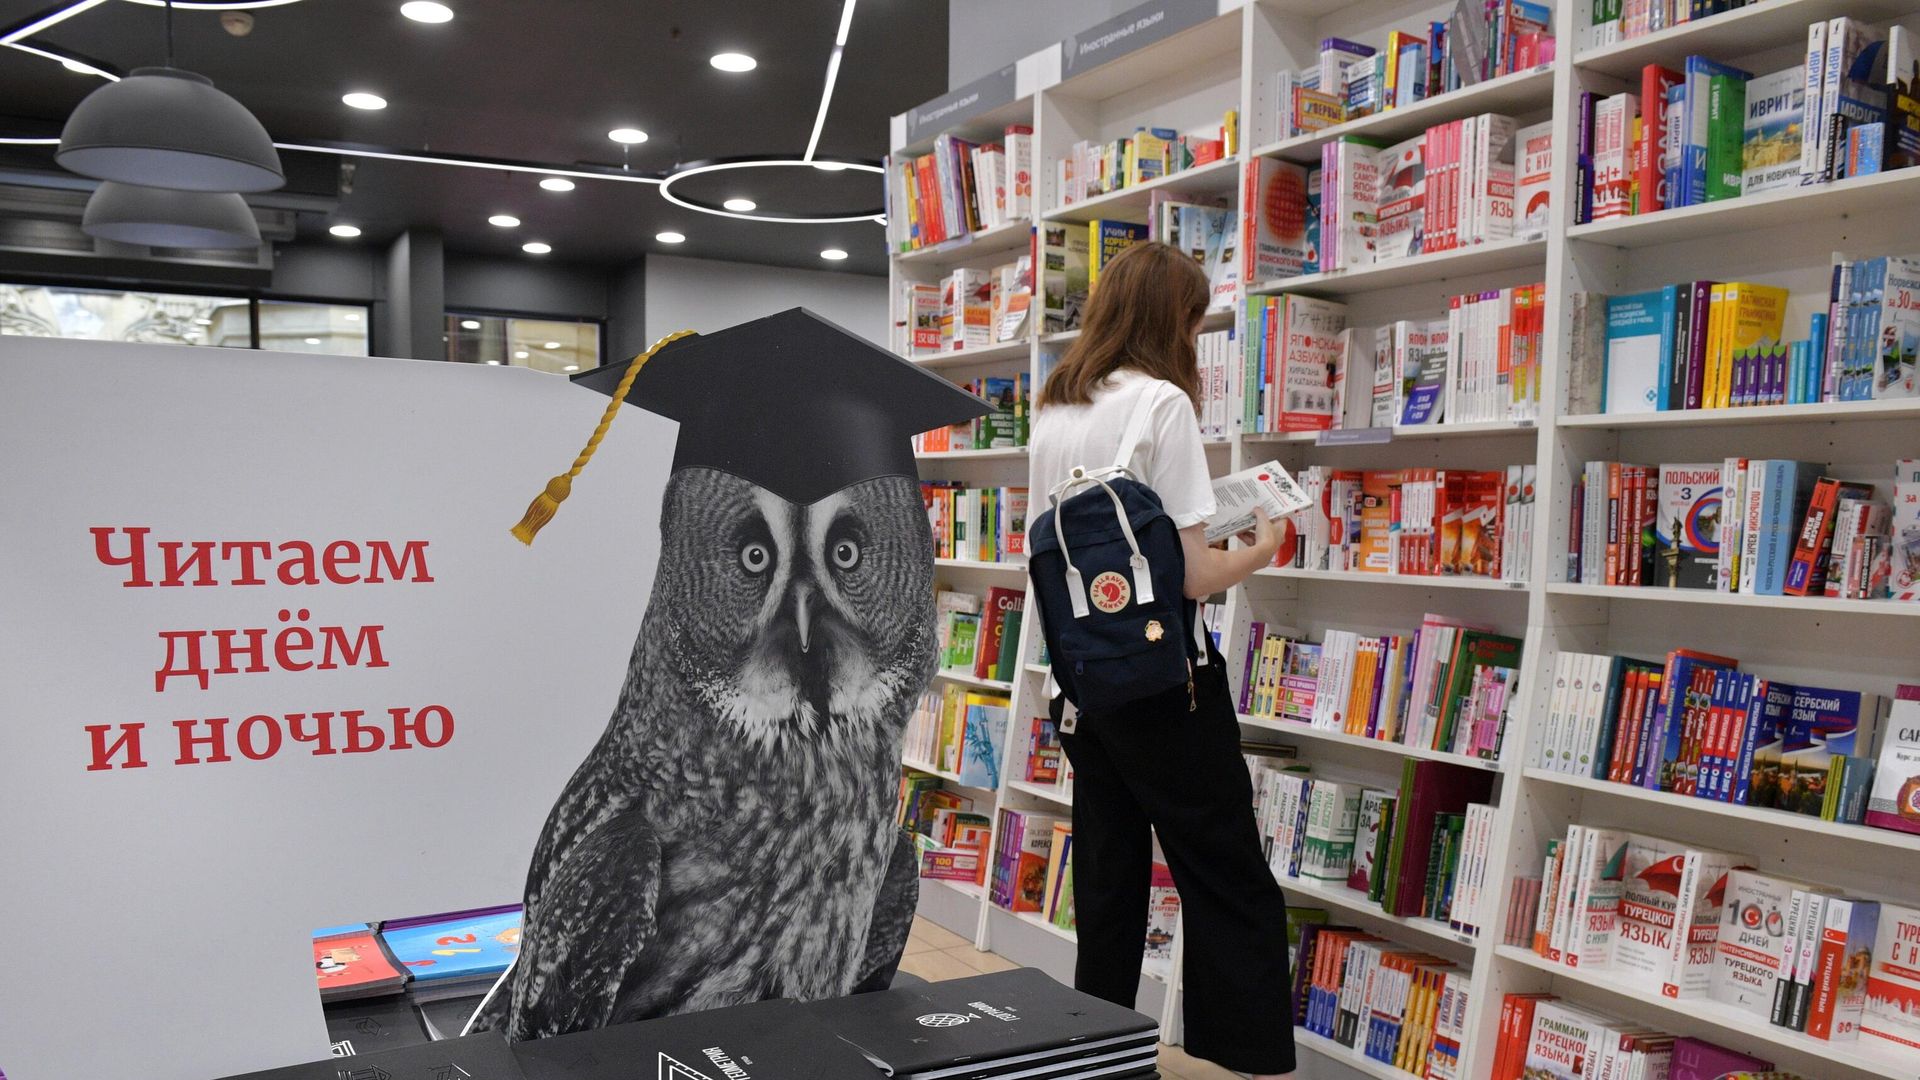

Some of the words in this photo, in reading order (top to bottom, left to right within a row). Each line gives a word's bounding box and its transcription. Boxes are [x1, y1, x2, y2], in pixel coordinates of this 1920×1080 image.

[1080, 23, 1135, 55] Иностранные
[1135, 10, 1164, 31] языки
[1750, 93, 1791, 119] ИВРИТ
[1897, 290, 1910, 309] 30
[1665, 468, 1720, 485] ПОЛЬСКИЙ
[1681, 487, 1692, 500] 3
[1748, 490, 1760, 532] ПОЛЬСКИЙ
[89, 527, 434, 588] Читаем
[155, 608, 389, 692] днём
[1793, 695, 1841, 712] СЕРБСКИЙ
[1792, 709, 1817, 723] ЯЗЫК
[84, 722, 148, 771] и
[172, 705, 455, 765] ночью
[935, 856, 952, 866] 100
[1625, 890, 1660, 908] ПОЛНЫЙ
[1786, 897, 1801, 937] ТУРЕЦКИЙ
[1805, 901, 1820, 941] ТУРЕЦКИЙ
[1738, 931, 1769, 949] ДНЕЙ
[1892, 942, 1901, 961] С
[1723, 957, 1774, 980] ТУРЕЦКОГО
[1732, 971, 1762, 987] ЯЗЫКА
[1822, 952, 1835, 992] ТУРЕЦКИЙ
[968, 1001, 1021, 1022] ГЕОГРАФИЯ
[1818, 991, 1828, 1013] ЯЗЫК
[1534, 1044, 1570, 1066] ЯЗЫКА
